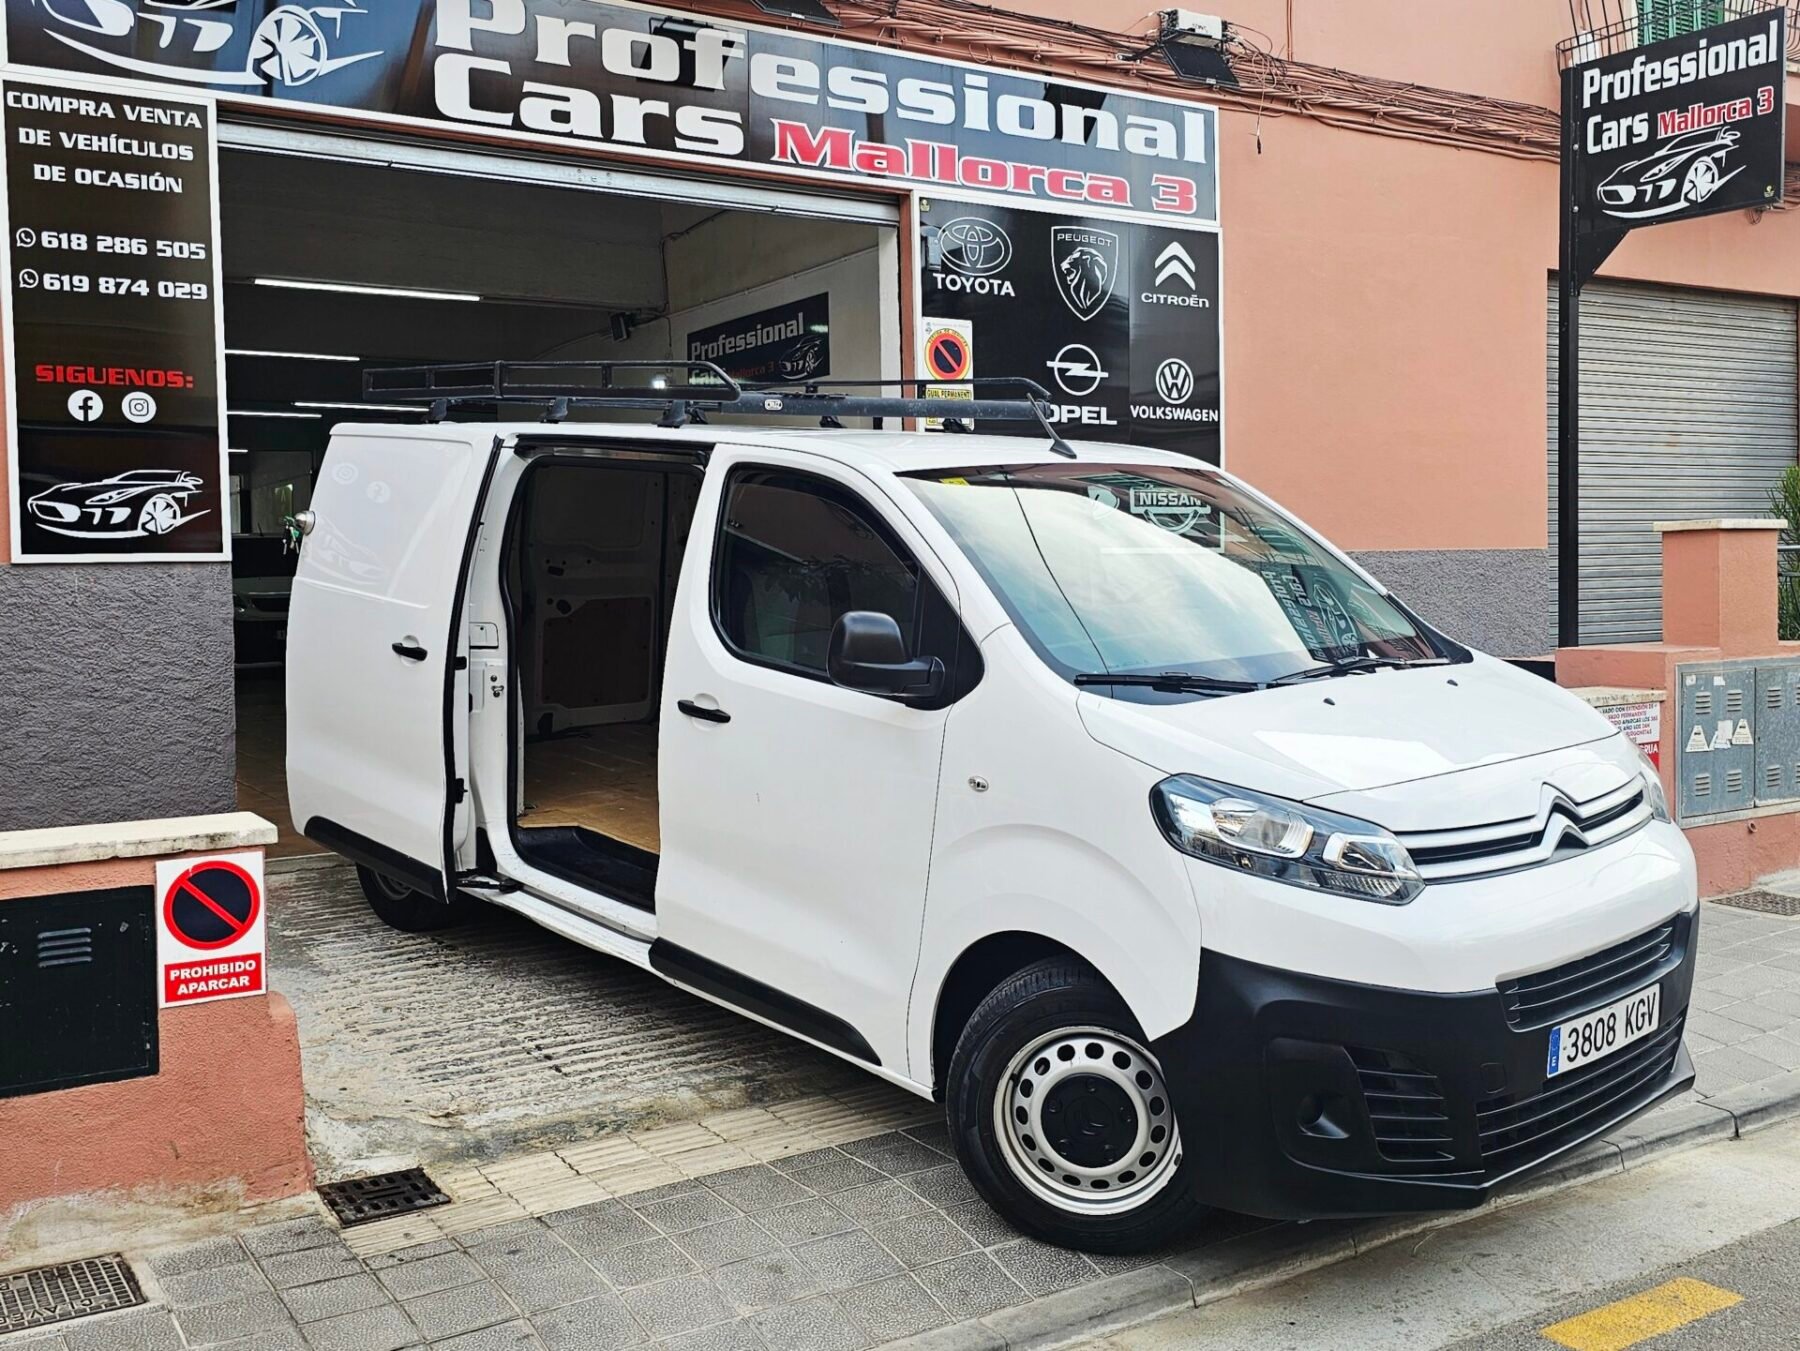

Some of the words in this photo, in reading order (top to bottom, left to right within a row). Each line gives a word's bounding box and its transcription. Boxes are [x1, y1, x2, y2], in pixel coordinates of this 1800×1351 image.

[1583, 20, 1778, 109] Professional
[435, 0, 1208, 165] Professional
[6, 91, 116, 119] COMPRA
[123, 104, 203, 129] VENTA
[1586, 112, 1649, 155] Cars
[1657, 97, 1753, 139] Mallorca
[1757, 85, 1775, 116] 3
[18, 127, 52, 147] DE
[59, 132, 194, 161] VEHÍCULOS
[434, 53, 745, 155] Cars
[769, 118, 1133, 207] Mallorca
[1151, 174, 1197, 215] 3
[33, 163, 67, 183] DE
[74, 171, 183, 194] OCASIÓN
[41, 231, 88, 251] 618
[96, 235, 148, 256] 286
[156, 240, 206, 260] 505
[1057, 233, 1113, 247] PEUGEOT
[43, 273, 90, 293] 619
[98, 277, 150, 297] 874
[157, 281, 208, 300] 029
[932, 272, 1016, 297] TOYOTA
[691, 312, 804, 361] Professional
[35, 364, 194, 388] SIGUENOS:
[1130, 405, 1218, 422] VOLKSWAGEN
[1140, 492, 1202, 506] NISSAN
[170, 960, 256, 981] PROHIBIDO
[177, 976, 250, 995] APARCAR
[1567, 1012, 1616, 1062] 3808
[1625, 992, 1656, 1038] KGV
